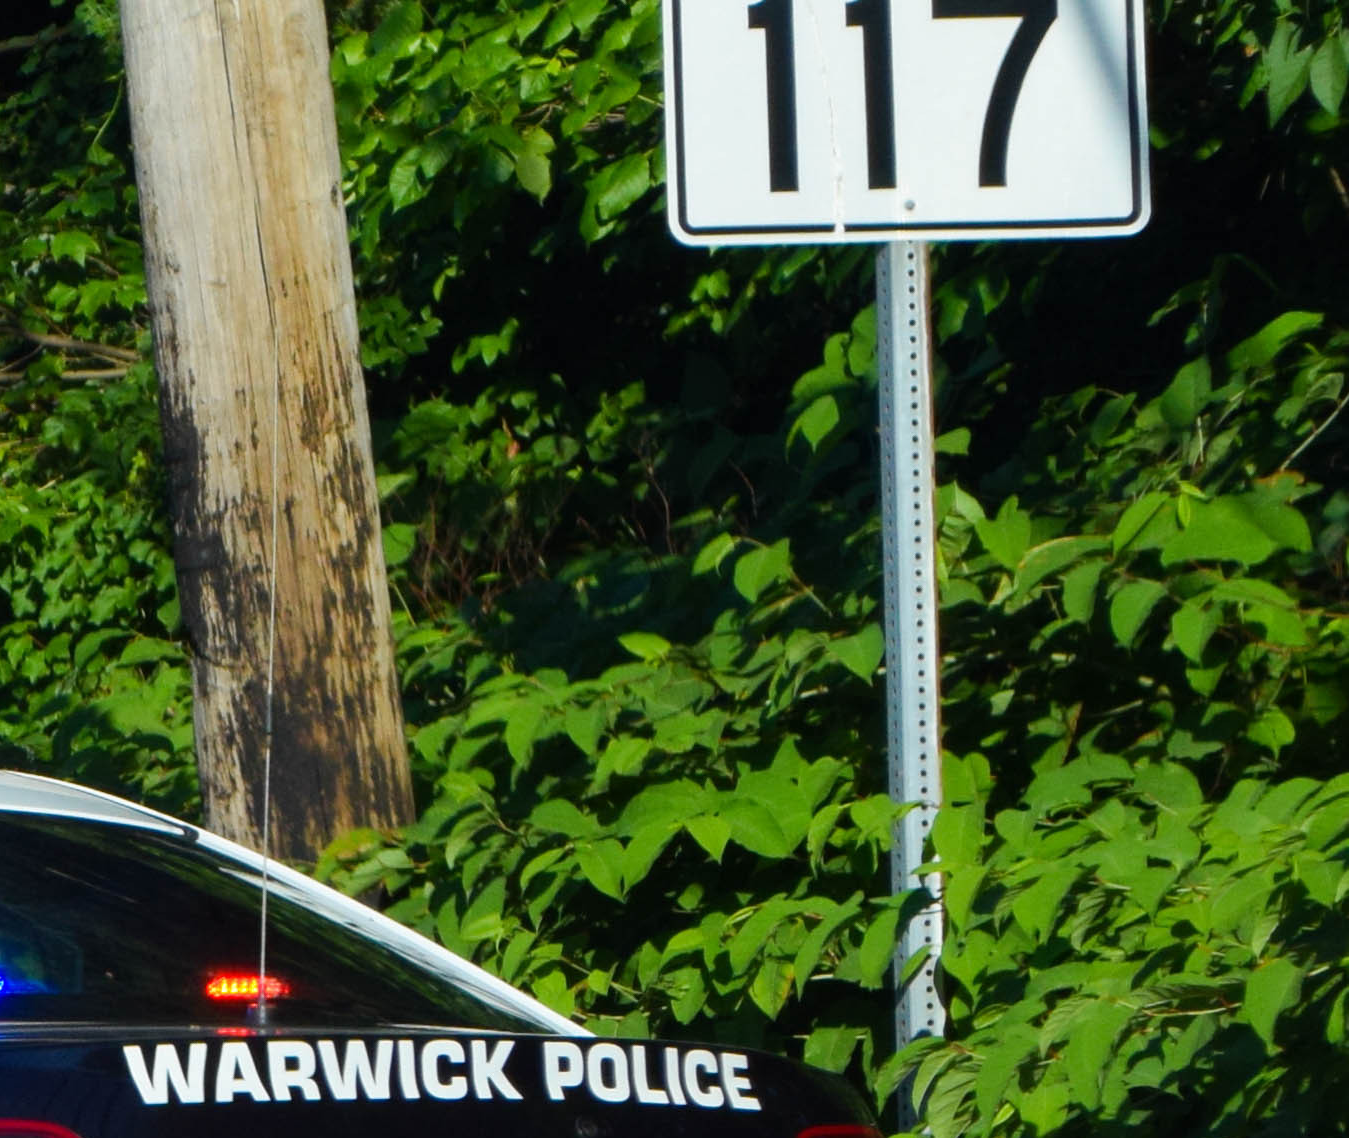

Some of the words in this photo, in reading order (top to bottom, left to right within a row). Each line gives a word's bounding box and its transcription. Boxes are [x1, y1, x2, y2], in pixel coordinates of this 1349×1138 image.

[747, 0, 1058, 192] 117
[122, 1038, 522, 1105] WARWICK
[543, 1042, 762, 1111] POLICE
